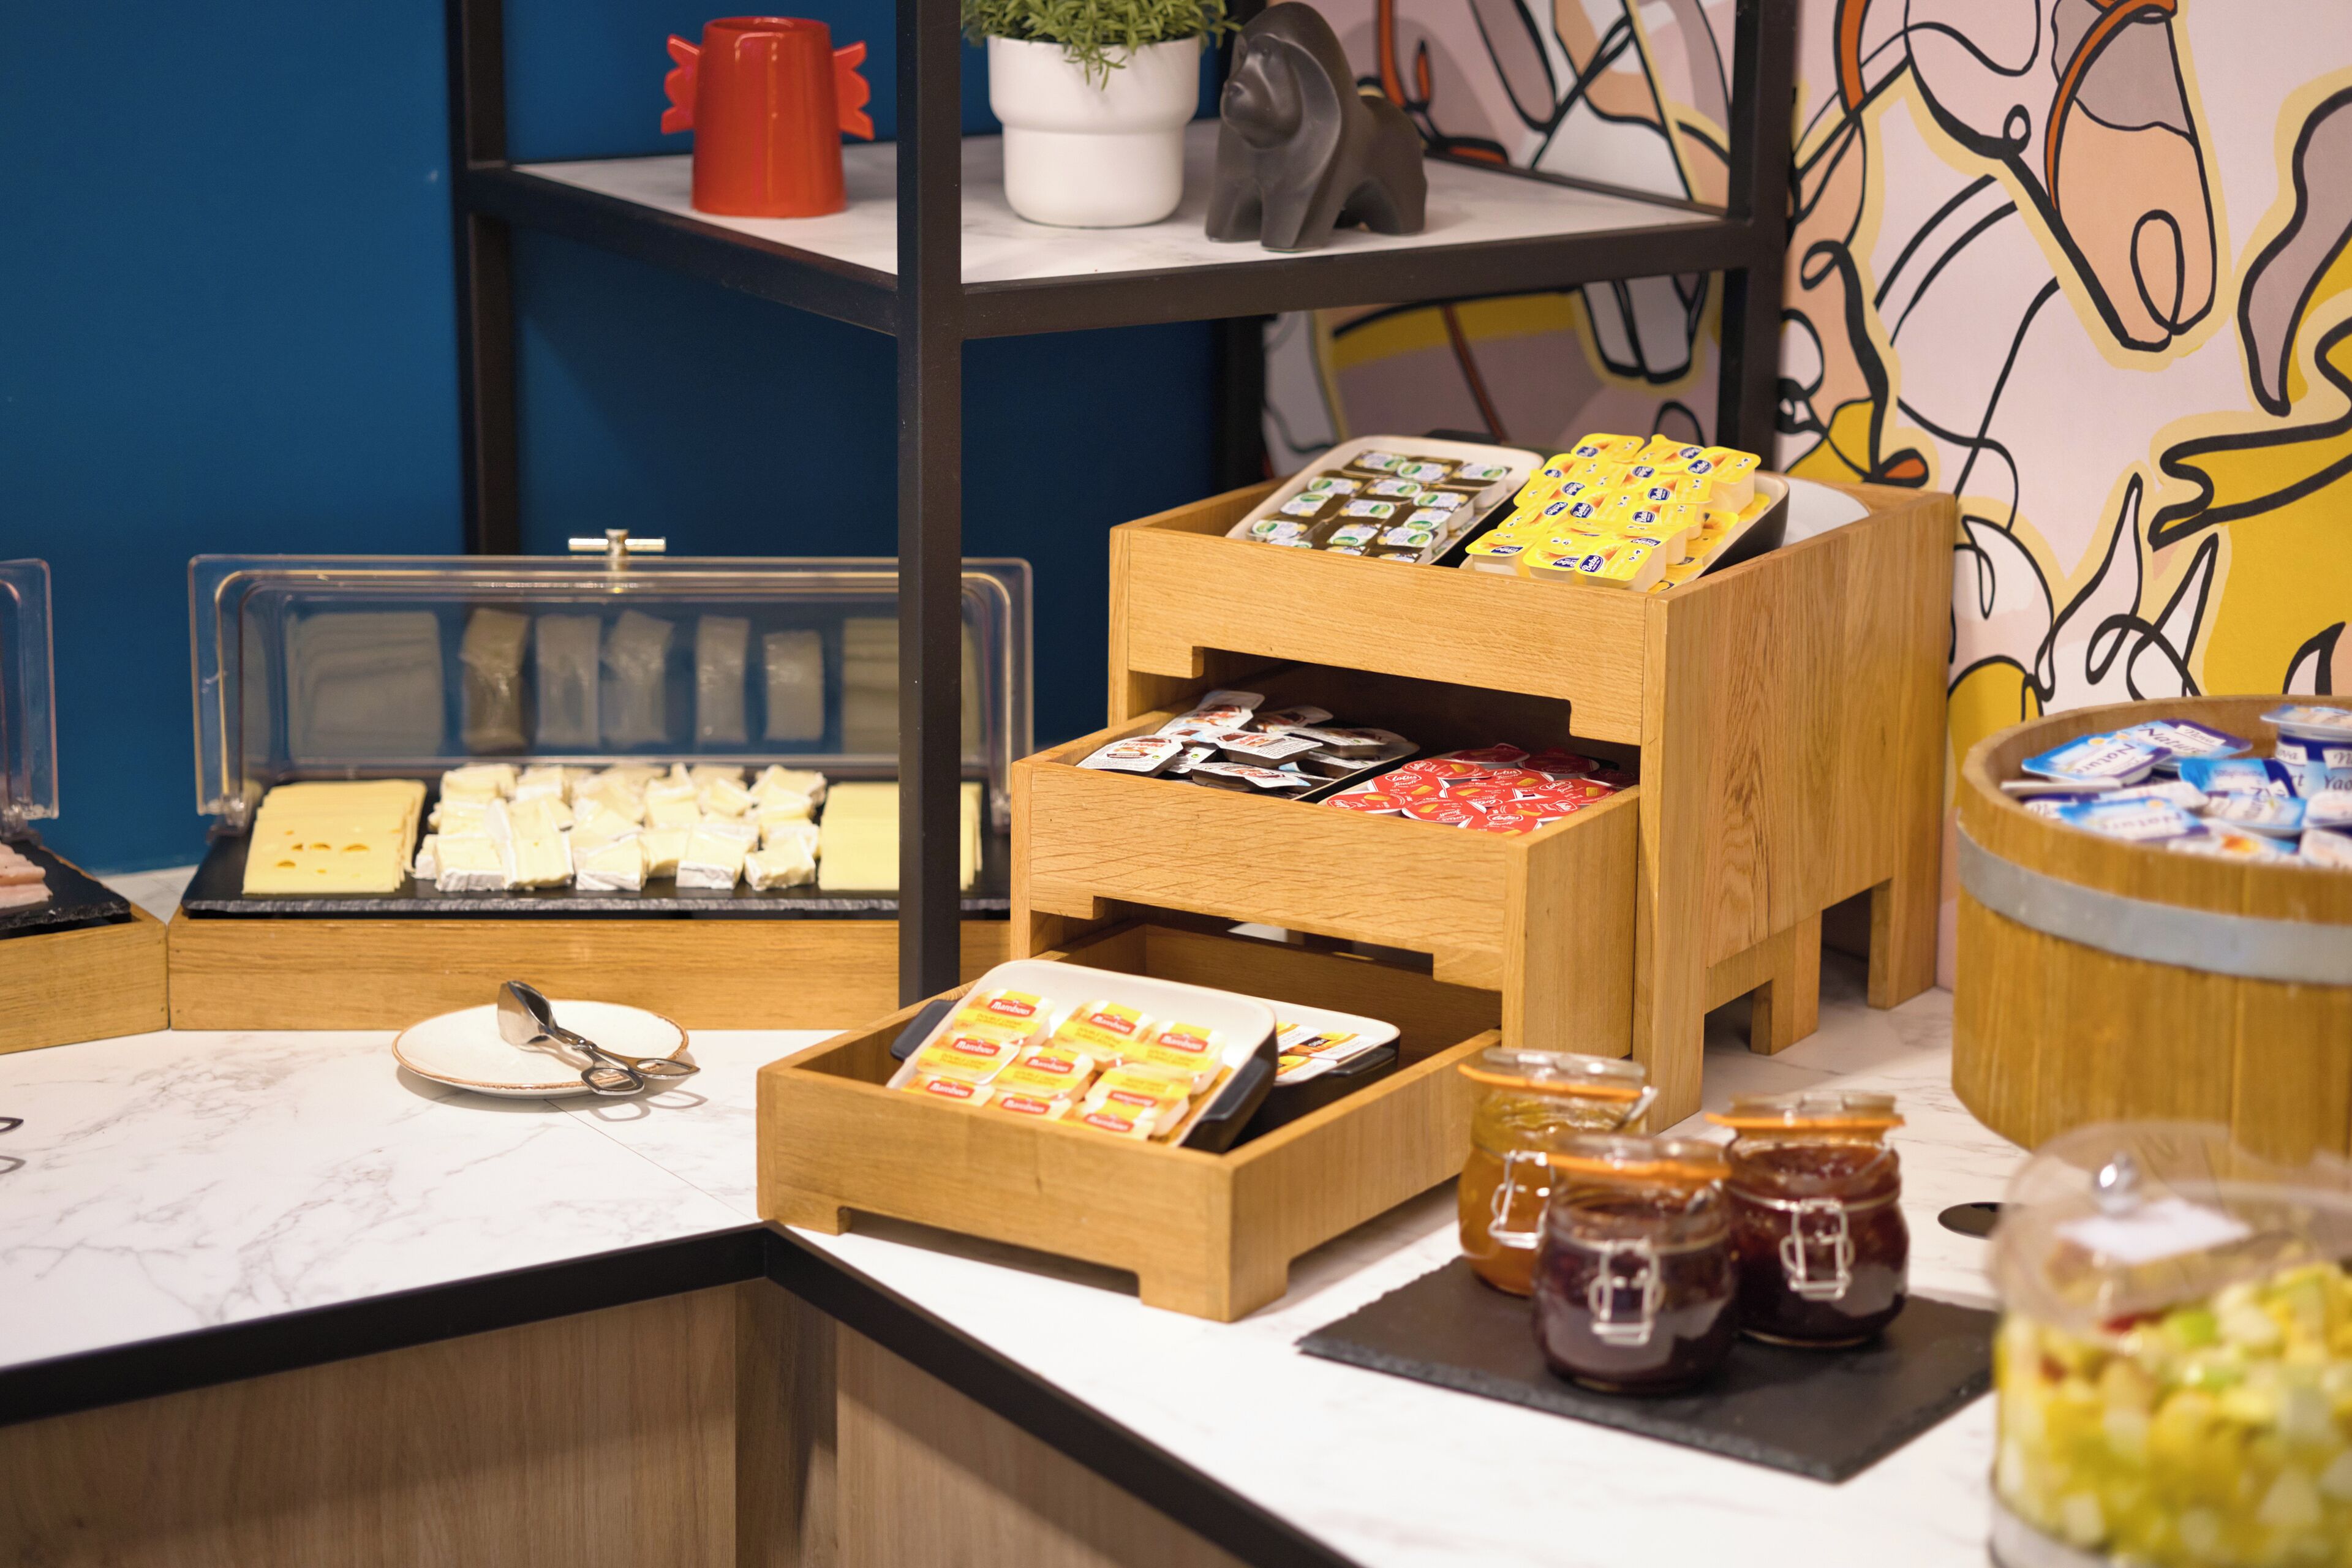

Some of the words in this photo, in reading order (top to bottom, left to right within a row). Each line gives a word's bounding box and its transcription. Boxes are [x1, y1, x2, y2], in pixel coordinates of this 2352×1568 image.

[1581, 556, 1599, 571] Bebo
[2138, 728, 2206, 753] Nature
[2075, 743, 2136, 774] Nature
[1547, 780, 1566, 790] Lotus
[990, 1001, 1031, 1016] Maredsous
[956, 1041, 995, 1055] Maredsous
